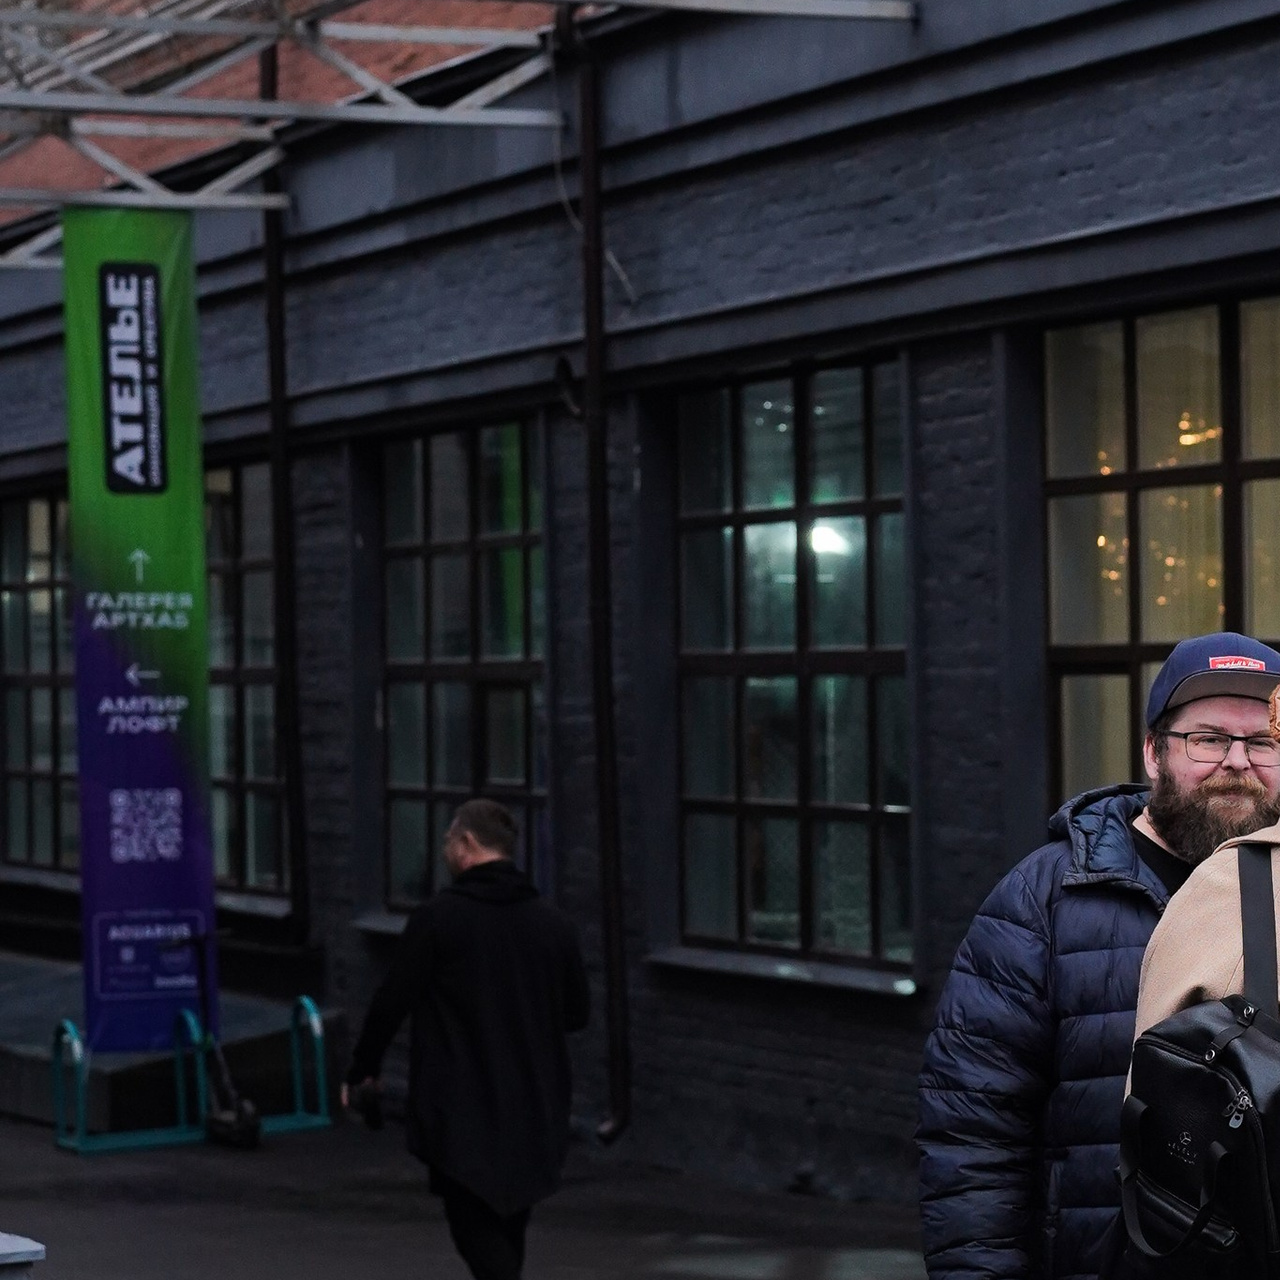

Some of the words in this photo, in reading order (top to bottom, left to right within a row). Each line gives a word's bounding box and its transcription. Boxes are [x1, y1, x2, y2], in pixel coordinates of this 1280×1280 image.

[105, 273, 146, 486] АТЕЛЬЕ
[86, 592, 193, 610] ГАЛЕРЕЯ
[92, 611, 189, 630] АРТХАБ
[98, 695, 189, 714] АМПИР
[106, 714, 181, 735] ЛОФТ
